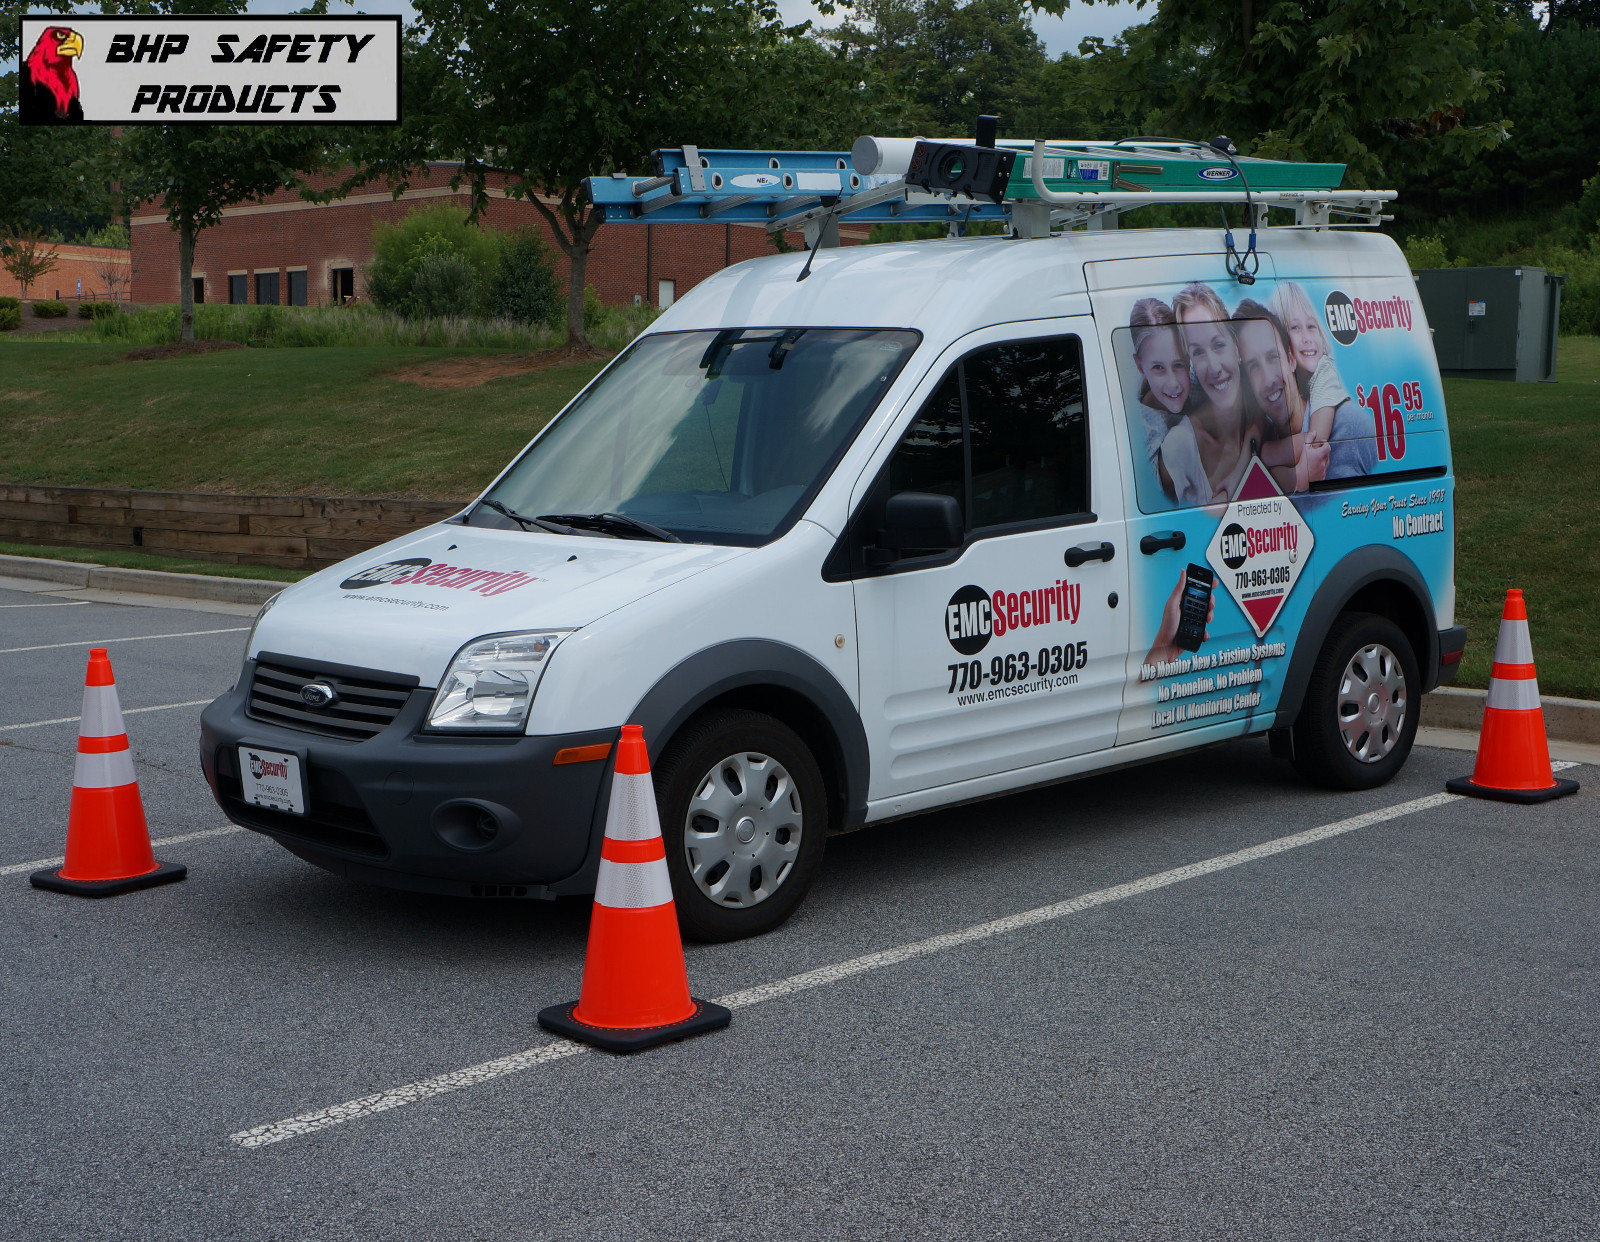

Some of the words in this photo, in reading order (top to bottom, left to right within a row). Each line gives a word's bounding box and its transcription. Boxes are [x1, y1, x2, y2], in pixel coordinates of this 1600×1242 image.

[1237, 501, 1272, 517] Protected
[1273, 500, 1283, 516] by
[1341, 501, 1370, 518] Earning
[1370, 498, 1388, 516] Your
[1388, 495, 1407, 511] Trust
[1408, 493, 1427, 509] Since
[1428, 489, 1446, 505] 1998
[1392, 515, 1405, 539] No
[1406, 510, 1444, 537] Contract
[1235, 566, 1290, 590] 770-963-0305
[342, 593, 450, 612] www.emcsecurity.com
[948, 641, 1088, 694] 770-963-0305
[1140, 663, 1156, 681] We
[1157, 658, 1192, 678] Monitor
[1192, 654, 1212, 672] New
[1211, 654, 1218, 668] &
[1218, 647, 1251, 667] Existing
[1251, 642, 1286, 661] Systems
[304, 688, 321, 702] Ford
[957, 674, 1079, 707] www.emcsecurity.com
[1158, 685, 1170, 703] No
[1171, 676, 1216, 699] Phoneline,
[1216, 674, 1228, 690] No
[1228, 668, 1263, 687] Problem
[1151, 707, 1175, 729] Local
[1176, 706, 1187, 722] UL
[1187, 697, 1233, 720] Monitoring
[1233, 692, 1262, 711] Center
